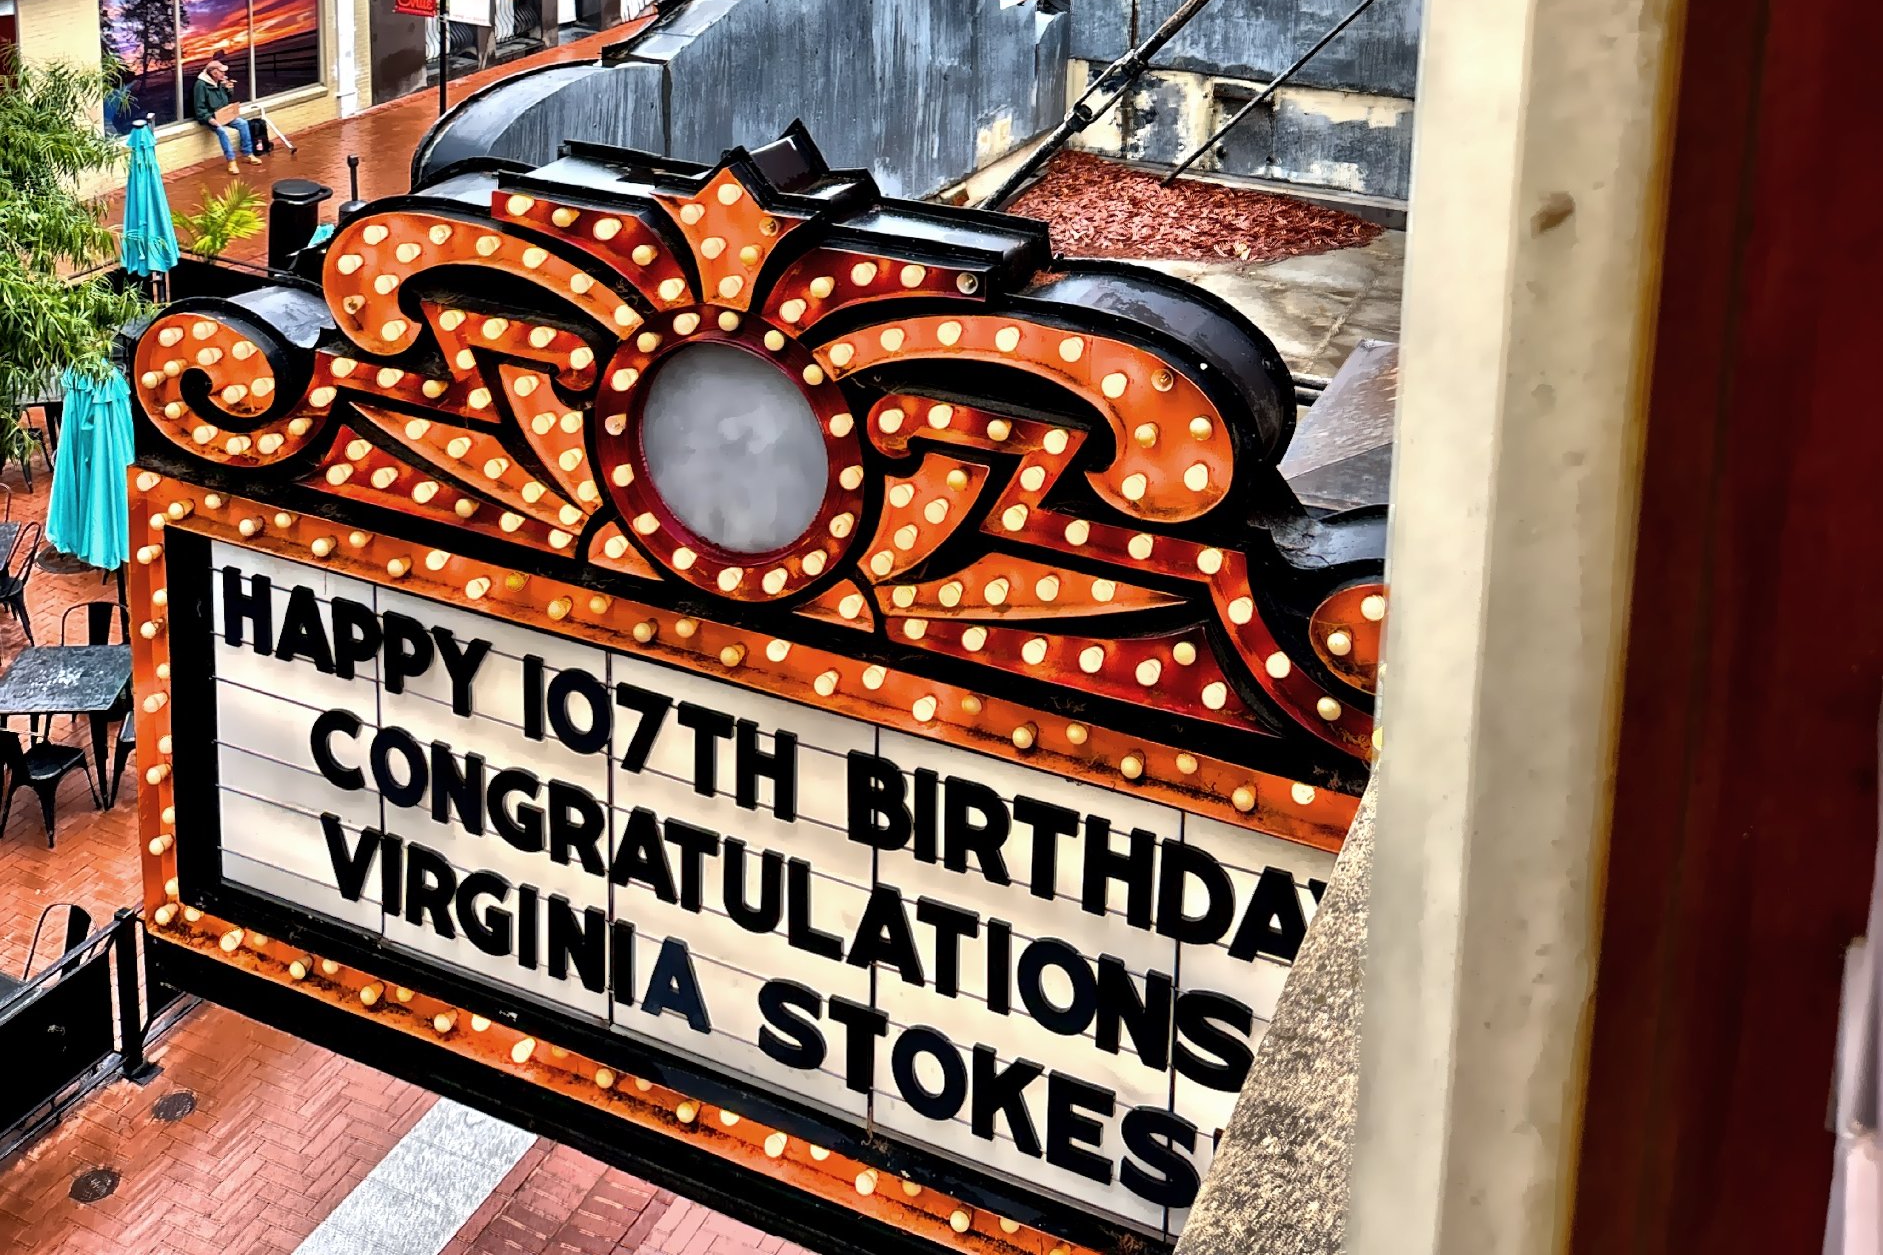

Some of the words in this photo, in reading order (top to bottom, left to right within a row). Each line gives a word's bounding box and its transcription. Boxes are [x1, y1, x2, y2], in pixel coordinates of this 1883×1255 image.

[222, 566, 491, 718] HAPPY
[522, 654, 798, 822] 107TH
[847, 749, 1329, 962] BIRTHDA
[310, 708, 1254, 1093] CONGRATULATIONS
[320, 812, 712, 1035] VIRGINIA
[757, 978, 1224, 1209] STOKES
